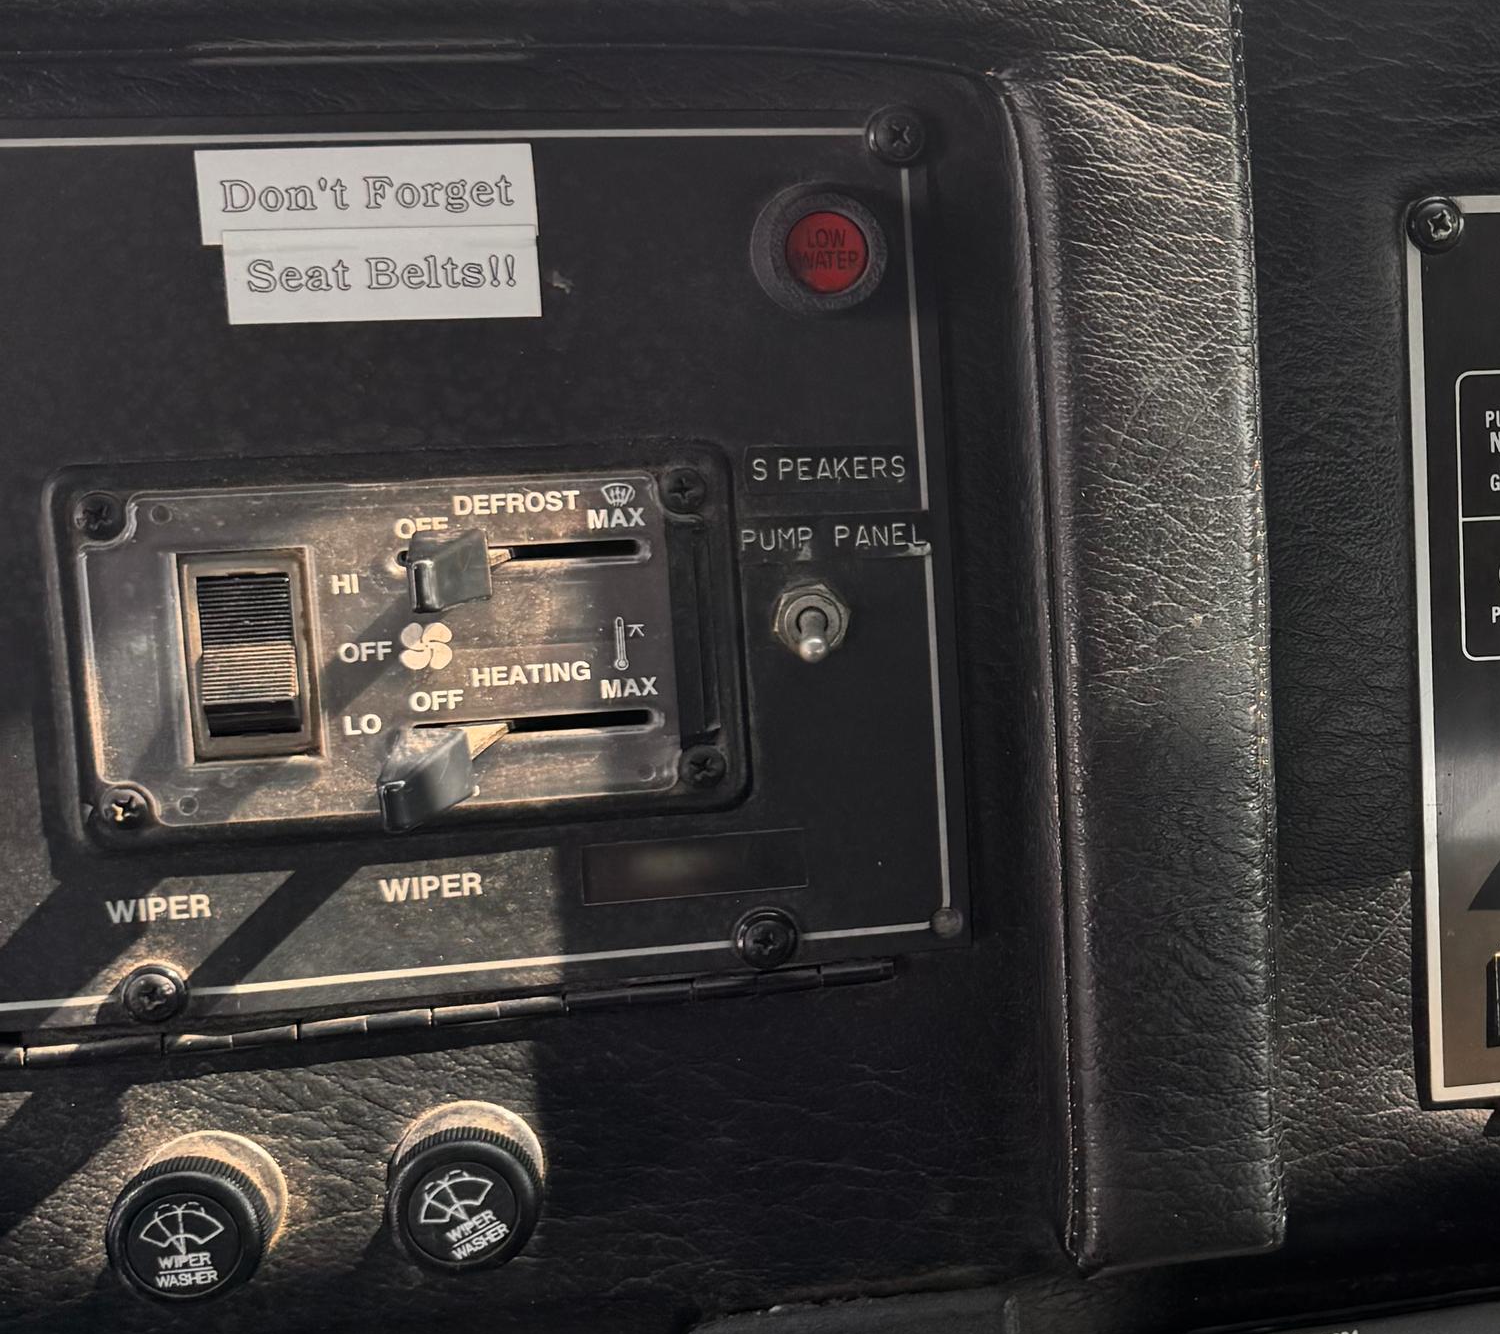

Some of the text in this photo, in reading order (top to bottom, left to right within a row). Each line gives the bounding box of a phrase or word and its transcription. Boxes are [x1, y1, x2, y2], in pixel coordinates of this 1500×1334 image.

[220, 175, 515, 213] Don't Forget
[807, 228, 846, 248] LOW
[797, 250, 860, 270] WATER
[248, 254, 517, 293] Seat Belts!!
[453, 490, 580, 516] DEFROST
[587, 507, 646, 530] MAX
[740, 523, 928, 552] PUMP PANEL
[331, 574, 359, 595] HI
[339, 641, 392, 664] OFF
[472, 660, 592, 688] HEATING
[600, 676, 658, 700] MAX
[409, 689, 464, 712] OFF
[344, 713, 382, 736] LO
[379, 872, 483, 902] WIPER
[105, 894, 212, 924] WIPER
[445, 1209, 498, 1243] WIPER
[451, 1223, 510, 1260] WASHER
[157, 1252, 212, 1270] WIPER
[155, 1269, 219, 1288] WASHER
